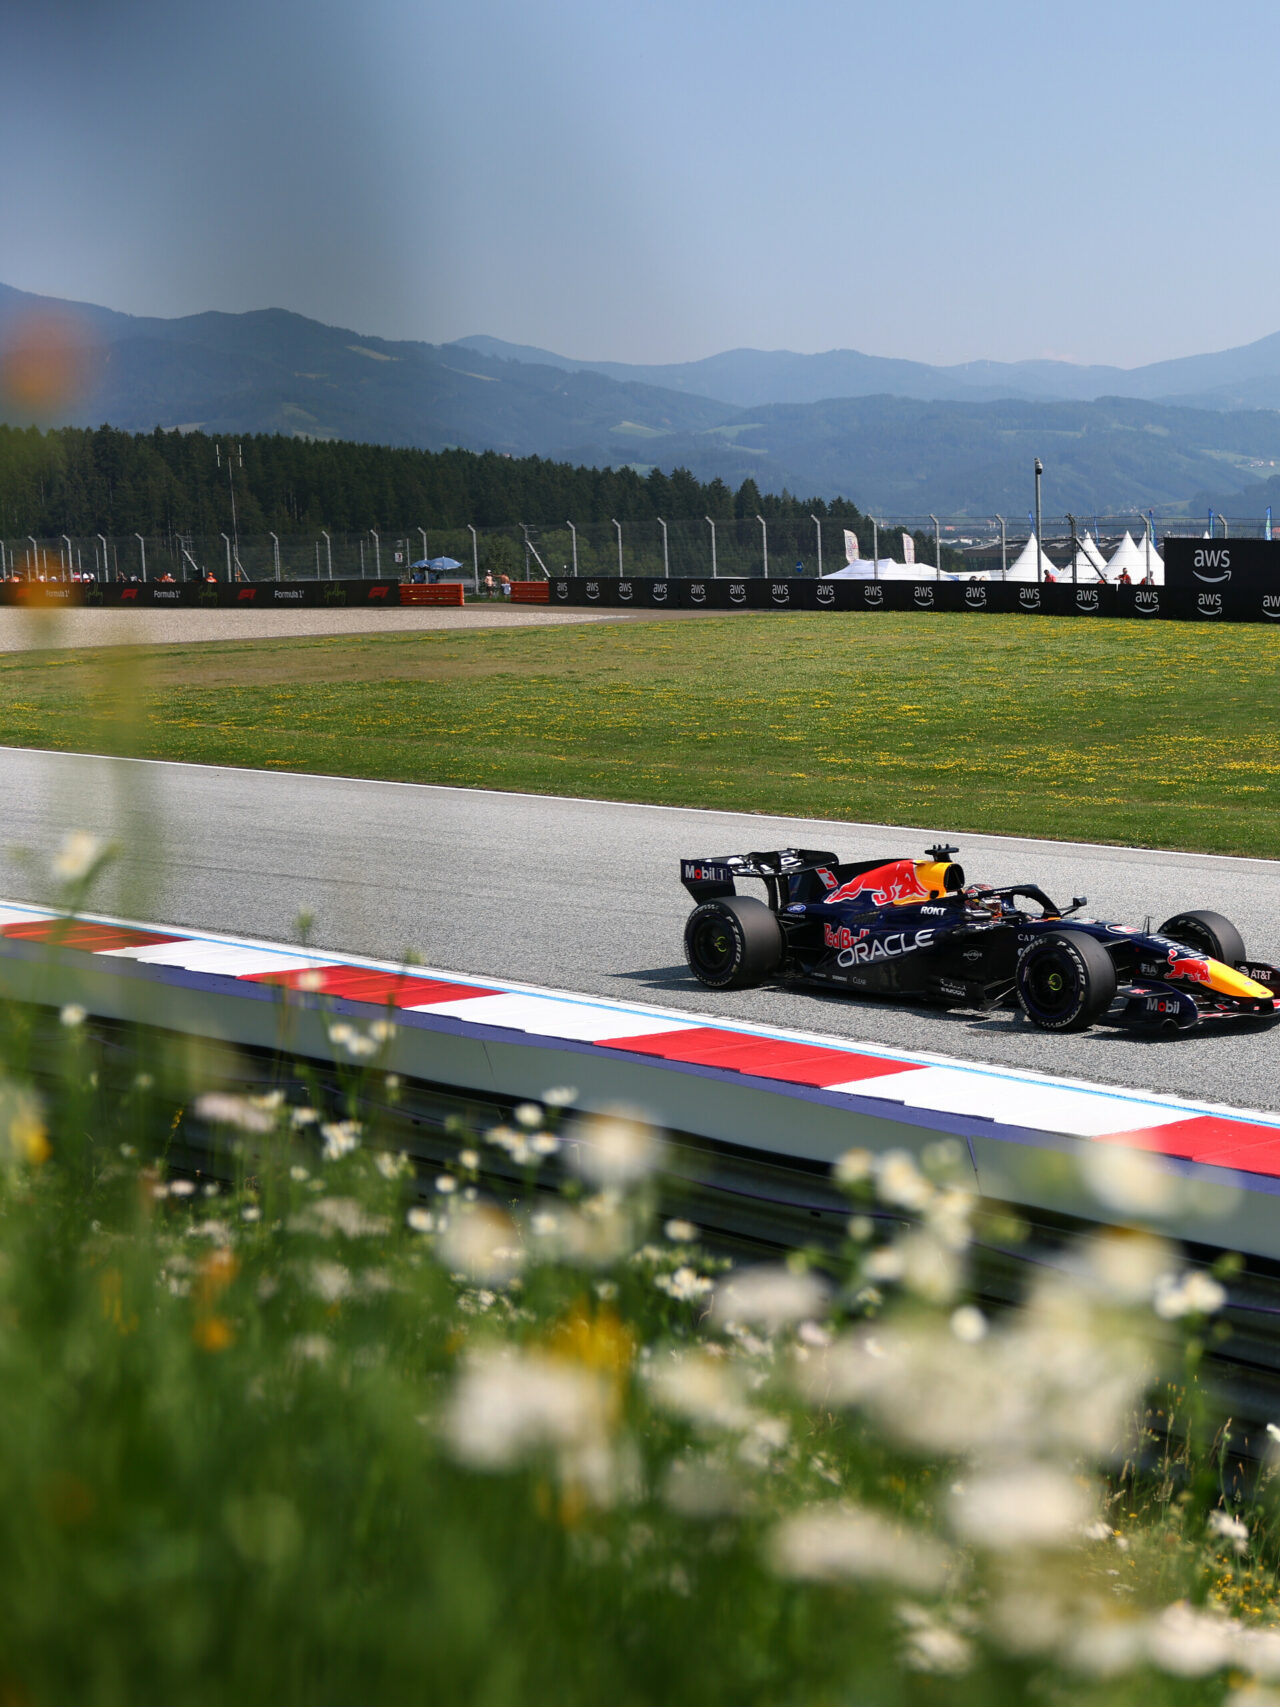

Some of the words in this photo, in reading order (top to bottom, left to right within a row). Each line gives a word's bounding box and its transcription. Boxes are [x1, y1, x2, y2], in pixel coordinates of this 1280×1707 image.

[1194, 549, 1230, 567] aws
[154, 590, 175, 598] Formula
[275, 590, 297, 598] Formula
[685, 864, 716, 880] Mobil
[920, 906, 947, 916] ROKT
[824, 923, 841, 949] Red
[837, 929, 936, 968] ORACLE
[1066, 948, 1086, 985] ZERO
[1250, 968, 1272, 981] AT&T
[1146, 998, 1180, 1014] Mobil
